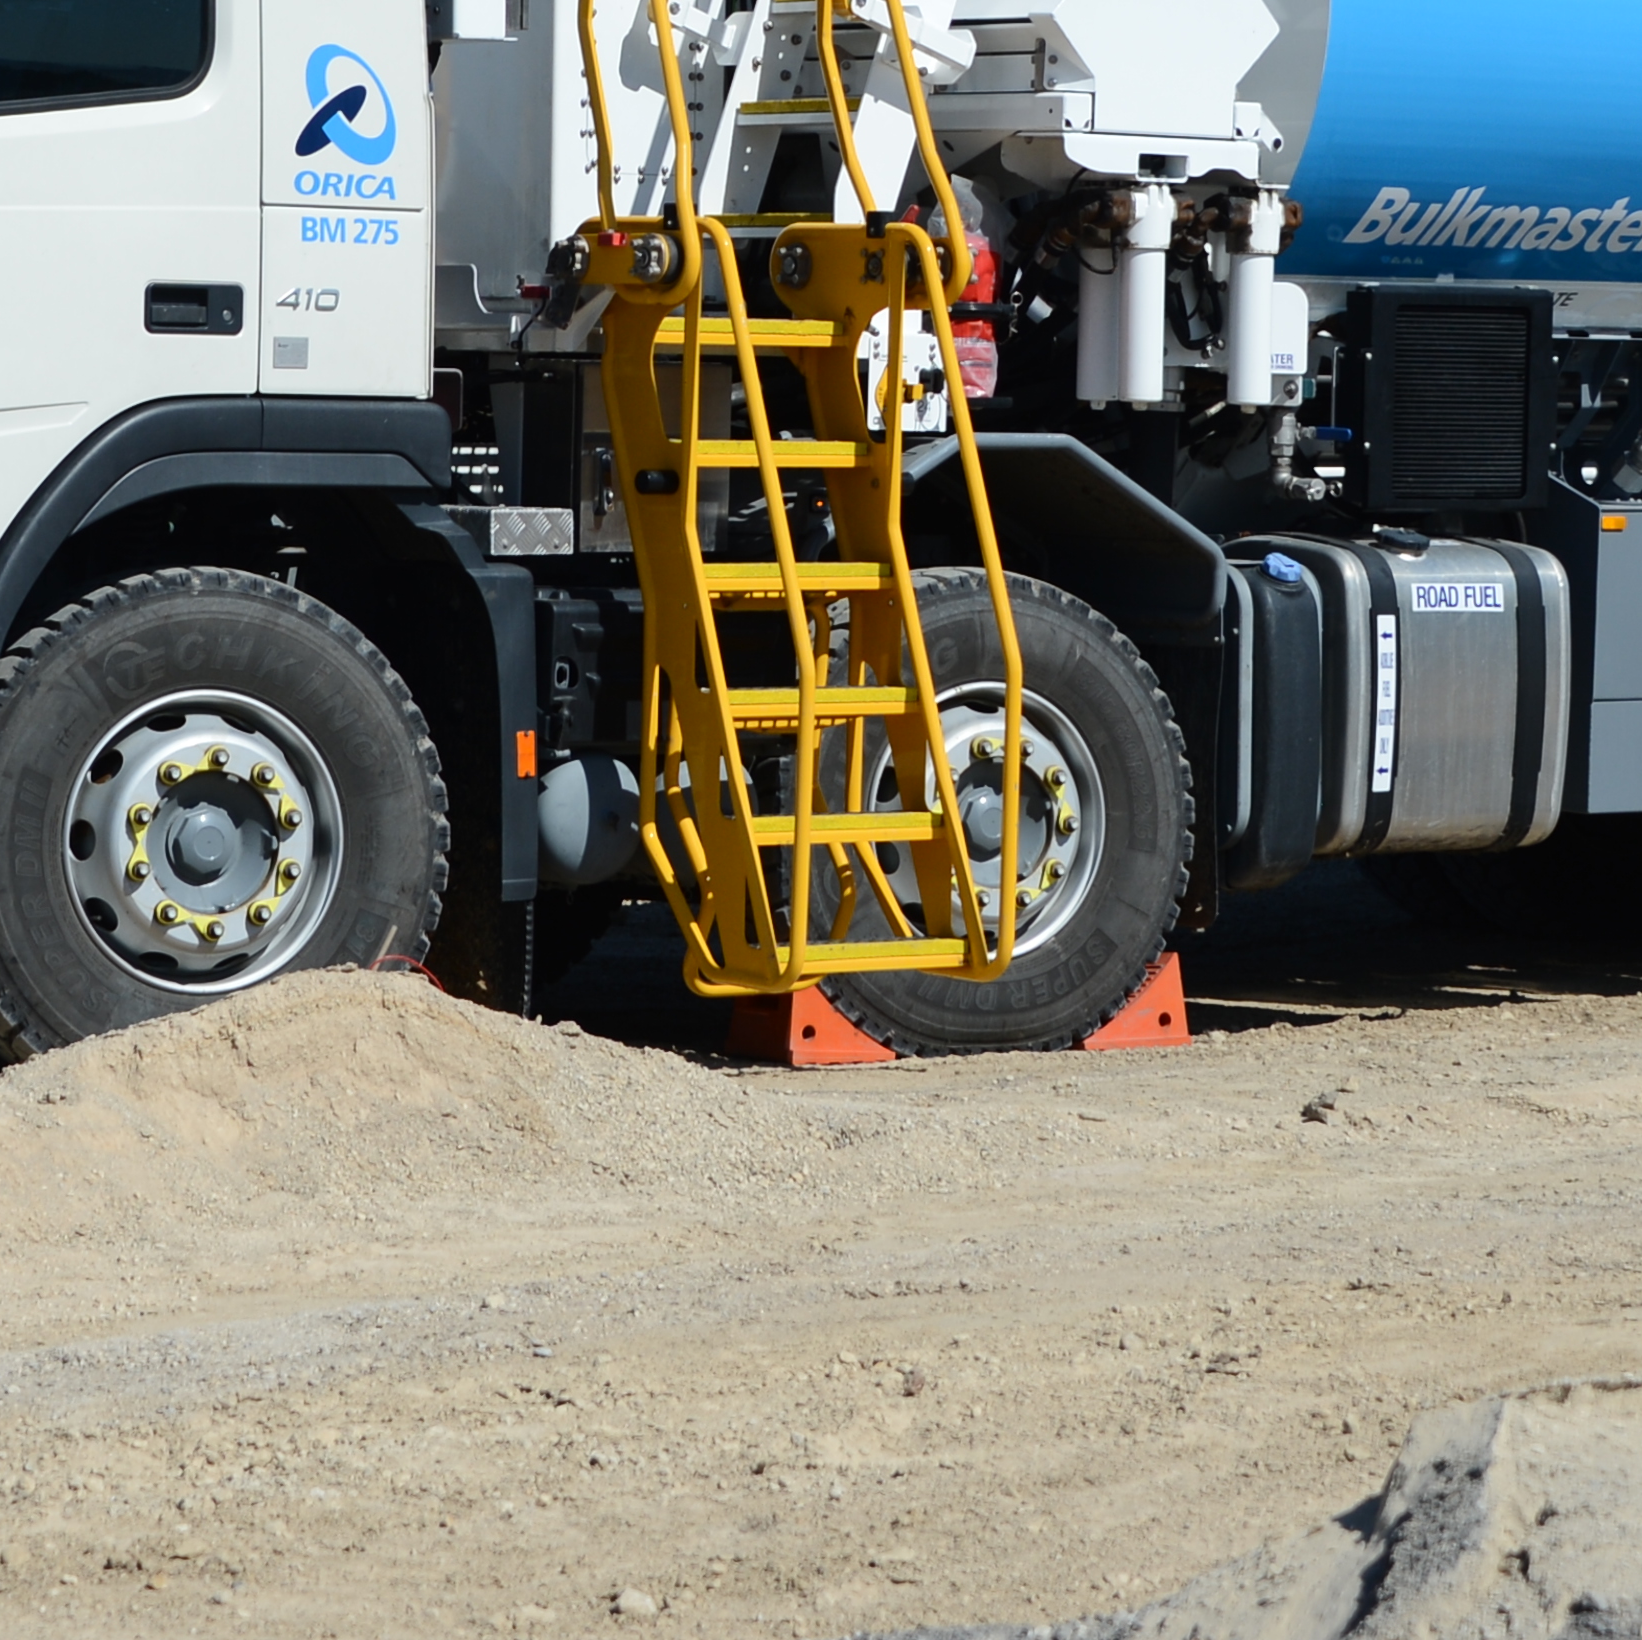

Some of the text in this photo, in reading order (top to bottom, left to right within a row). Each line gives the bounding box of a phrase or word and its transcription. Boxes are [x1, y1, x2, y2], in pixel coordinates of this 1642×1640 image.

[294, 170, 396, 201] ORICA
[301, 216, 400, 245] BM 275
[275, 287, 340, 312] 410
[1271, 354, 1294, 364] TER
[1416, 585, 1502, 609] ROAD FUEL
[21, 895, 109, 1012] SUPER
[1012, 936, 1110, 1011] SUPER
